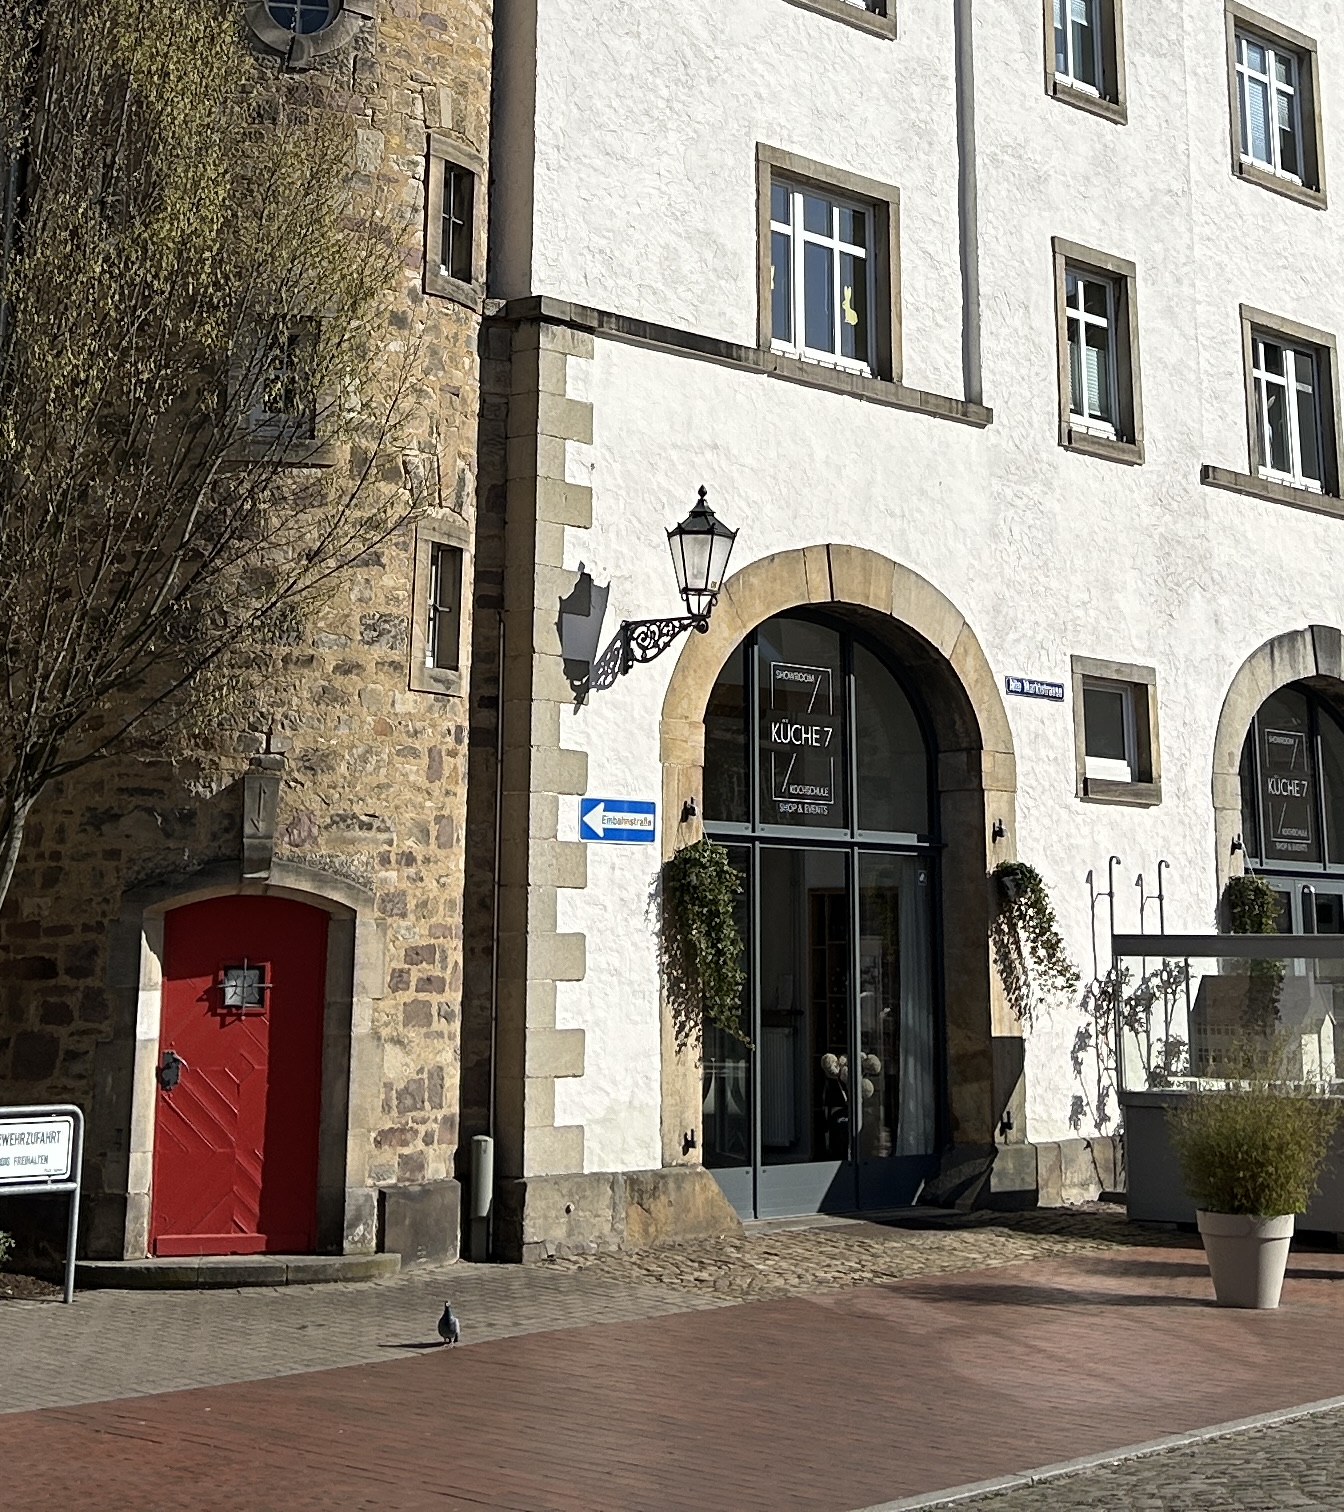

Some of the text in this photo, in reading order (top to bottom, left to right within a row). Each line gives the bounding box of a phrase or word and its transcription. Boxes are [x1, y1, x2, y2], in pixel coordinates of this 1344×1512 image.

[771, 718, 833, 747] KÜCHE 7
[789, 784, 829, 797] KOCHSCHULE
[1267, 774, 1308, 797] KÜCHE 7
[779, 802, 797, 813] SHOP
[804, 804, 828, 815] EVENTS
